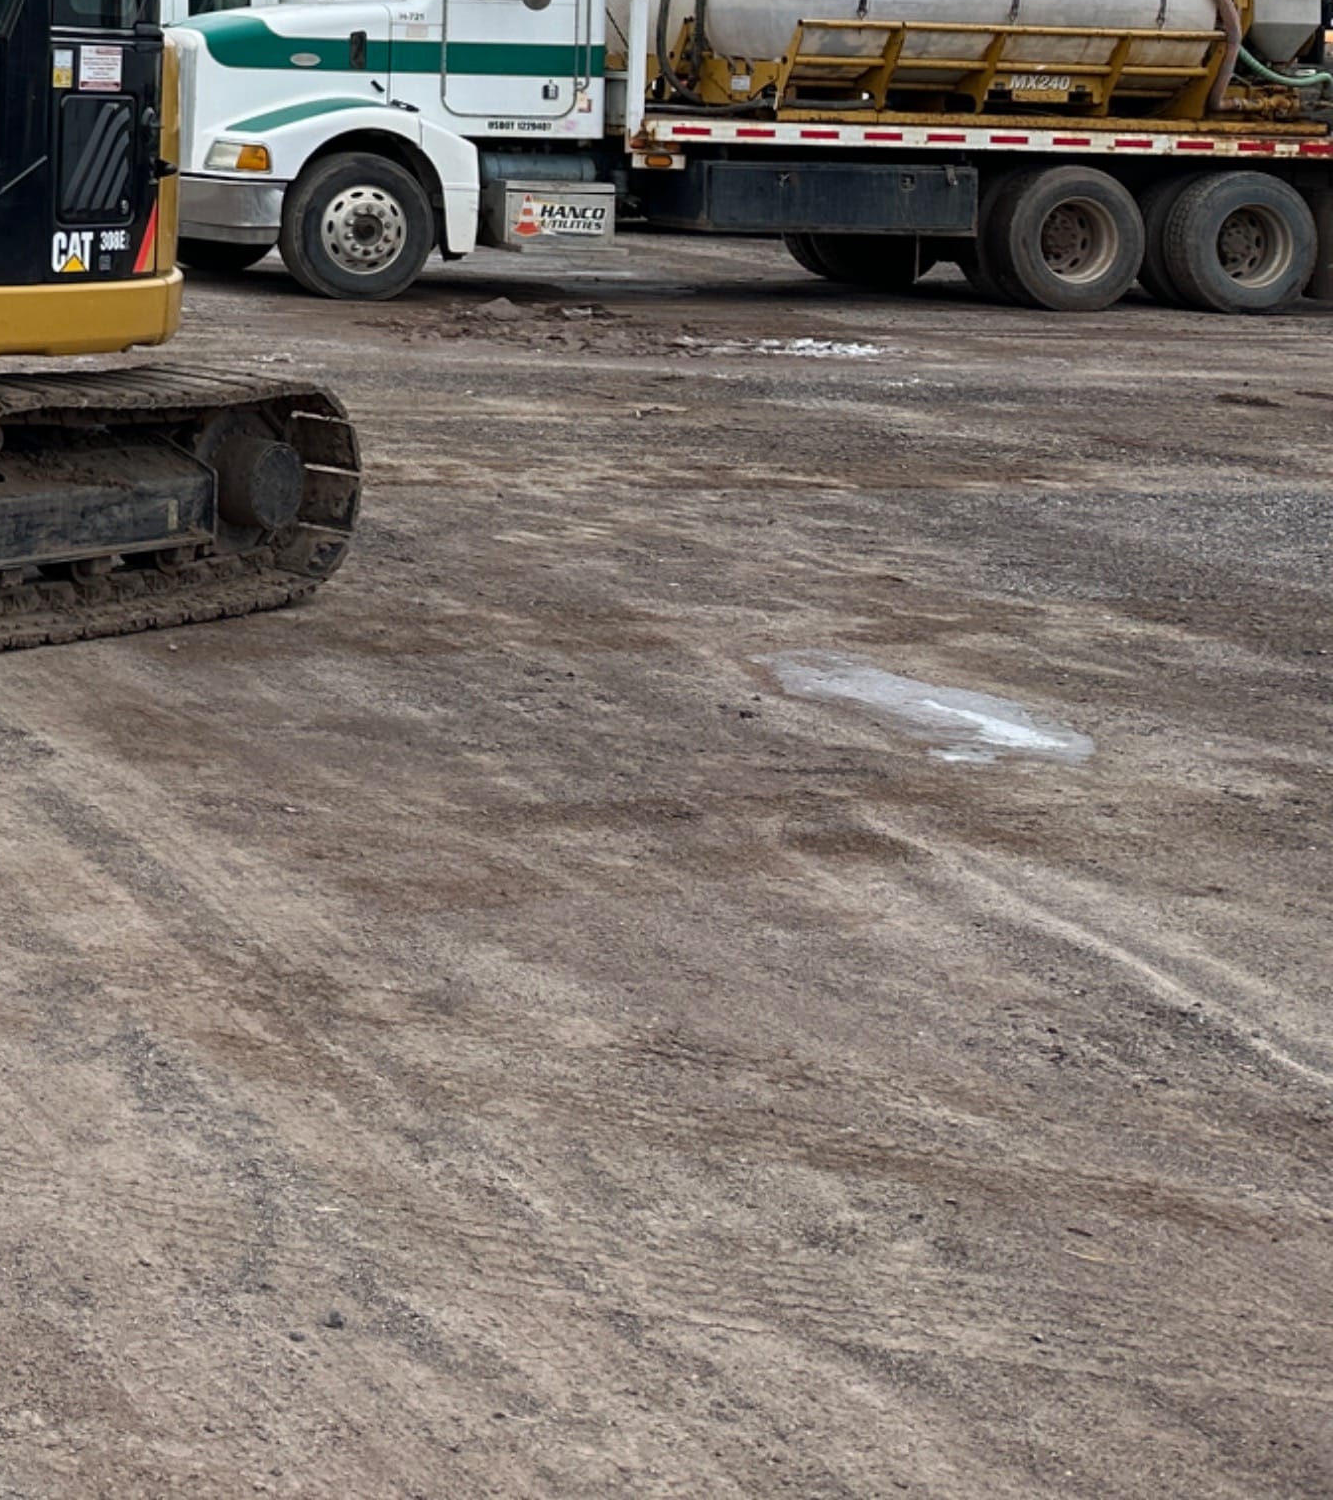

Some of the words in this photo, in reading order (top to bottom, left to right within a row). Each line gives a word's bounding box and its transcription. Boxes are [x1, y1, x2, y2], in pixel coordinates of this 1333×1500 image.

[1010, 75, 1070, 90] MX240
[541, 204, 606, 220] HANCO
[541, 219, 602, 229] UTILITIES
[52, 231, 94, 272] CAT
